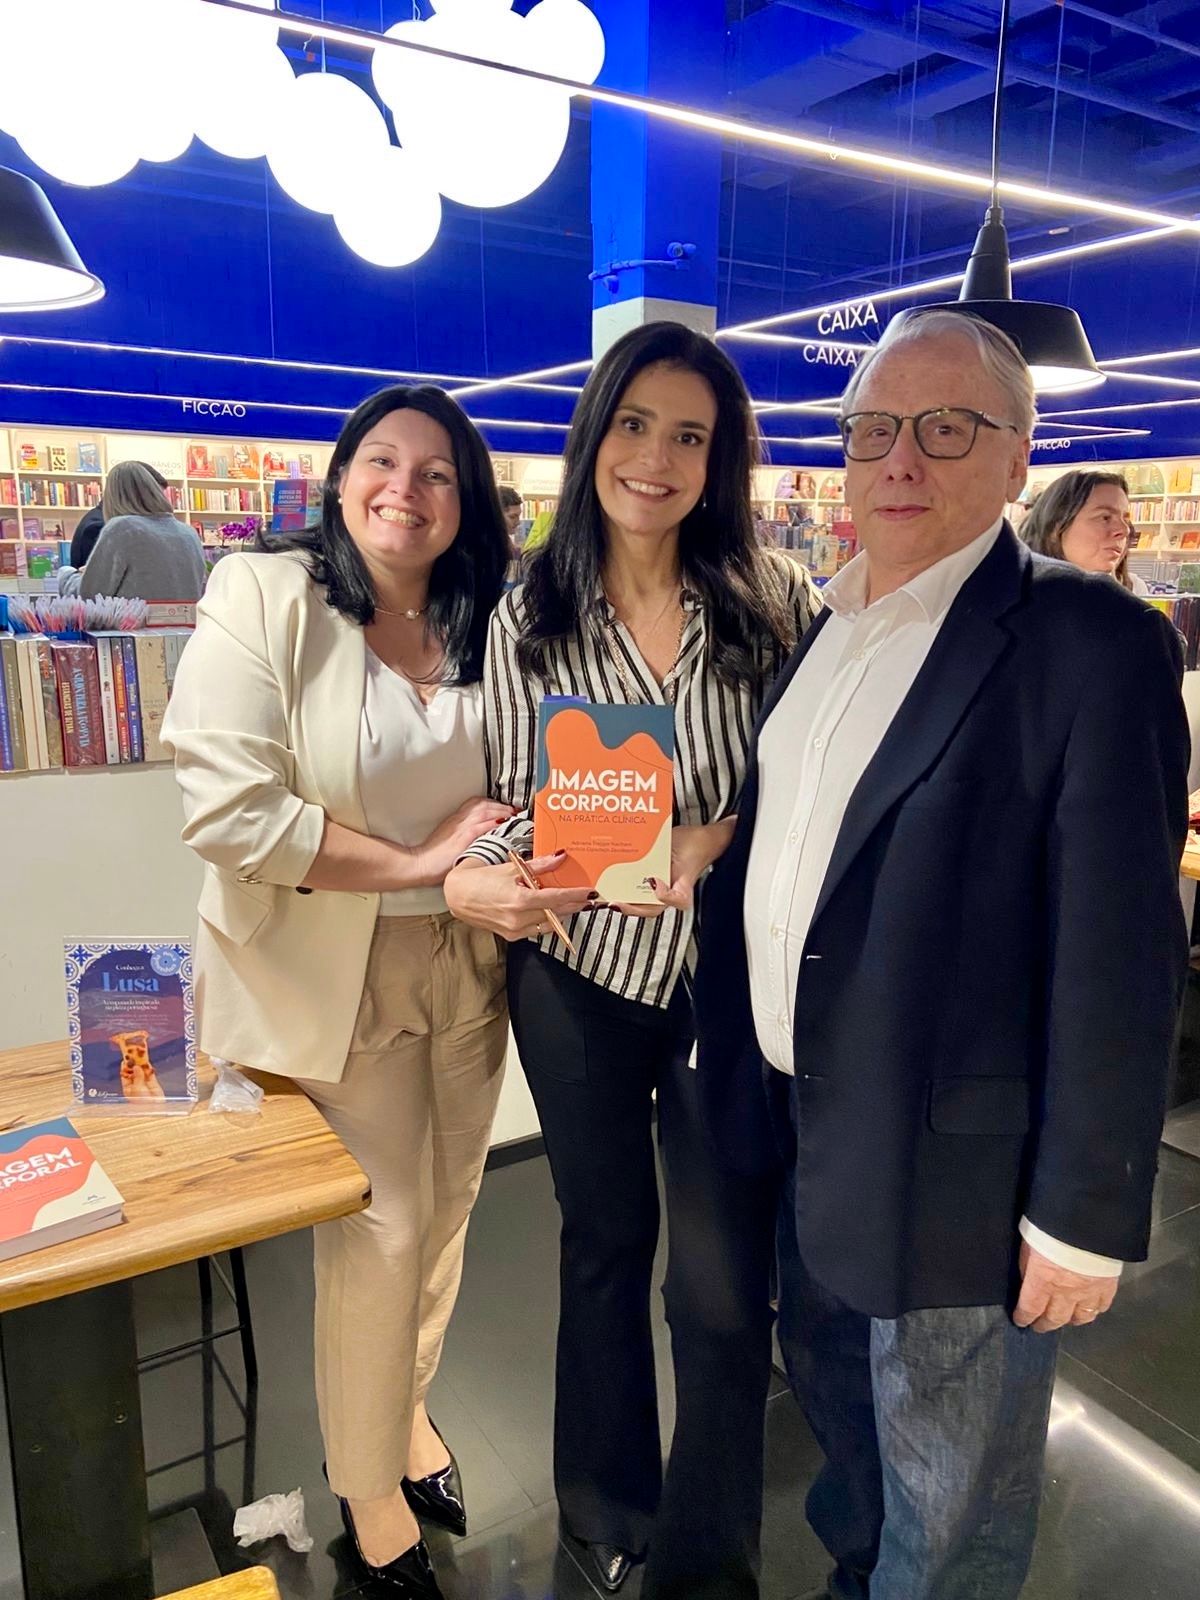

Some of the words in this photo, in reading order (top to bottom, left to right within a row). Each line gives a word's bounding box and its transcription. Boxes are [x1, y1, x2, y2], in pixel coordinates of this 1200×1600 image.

[818, 302, 878, 335] CAIXA
[803, 345, 857, 367] CAIXA
[551, 768, 656, 792] IMAGEM
[547, 793, 660, 813] CORPORAL
[103, 972, 159, 992] Lusa
